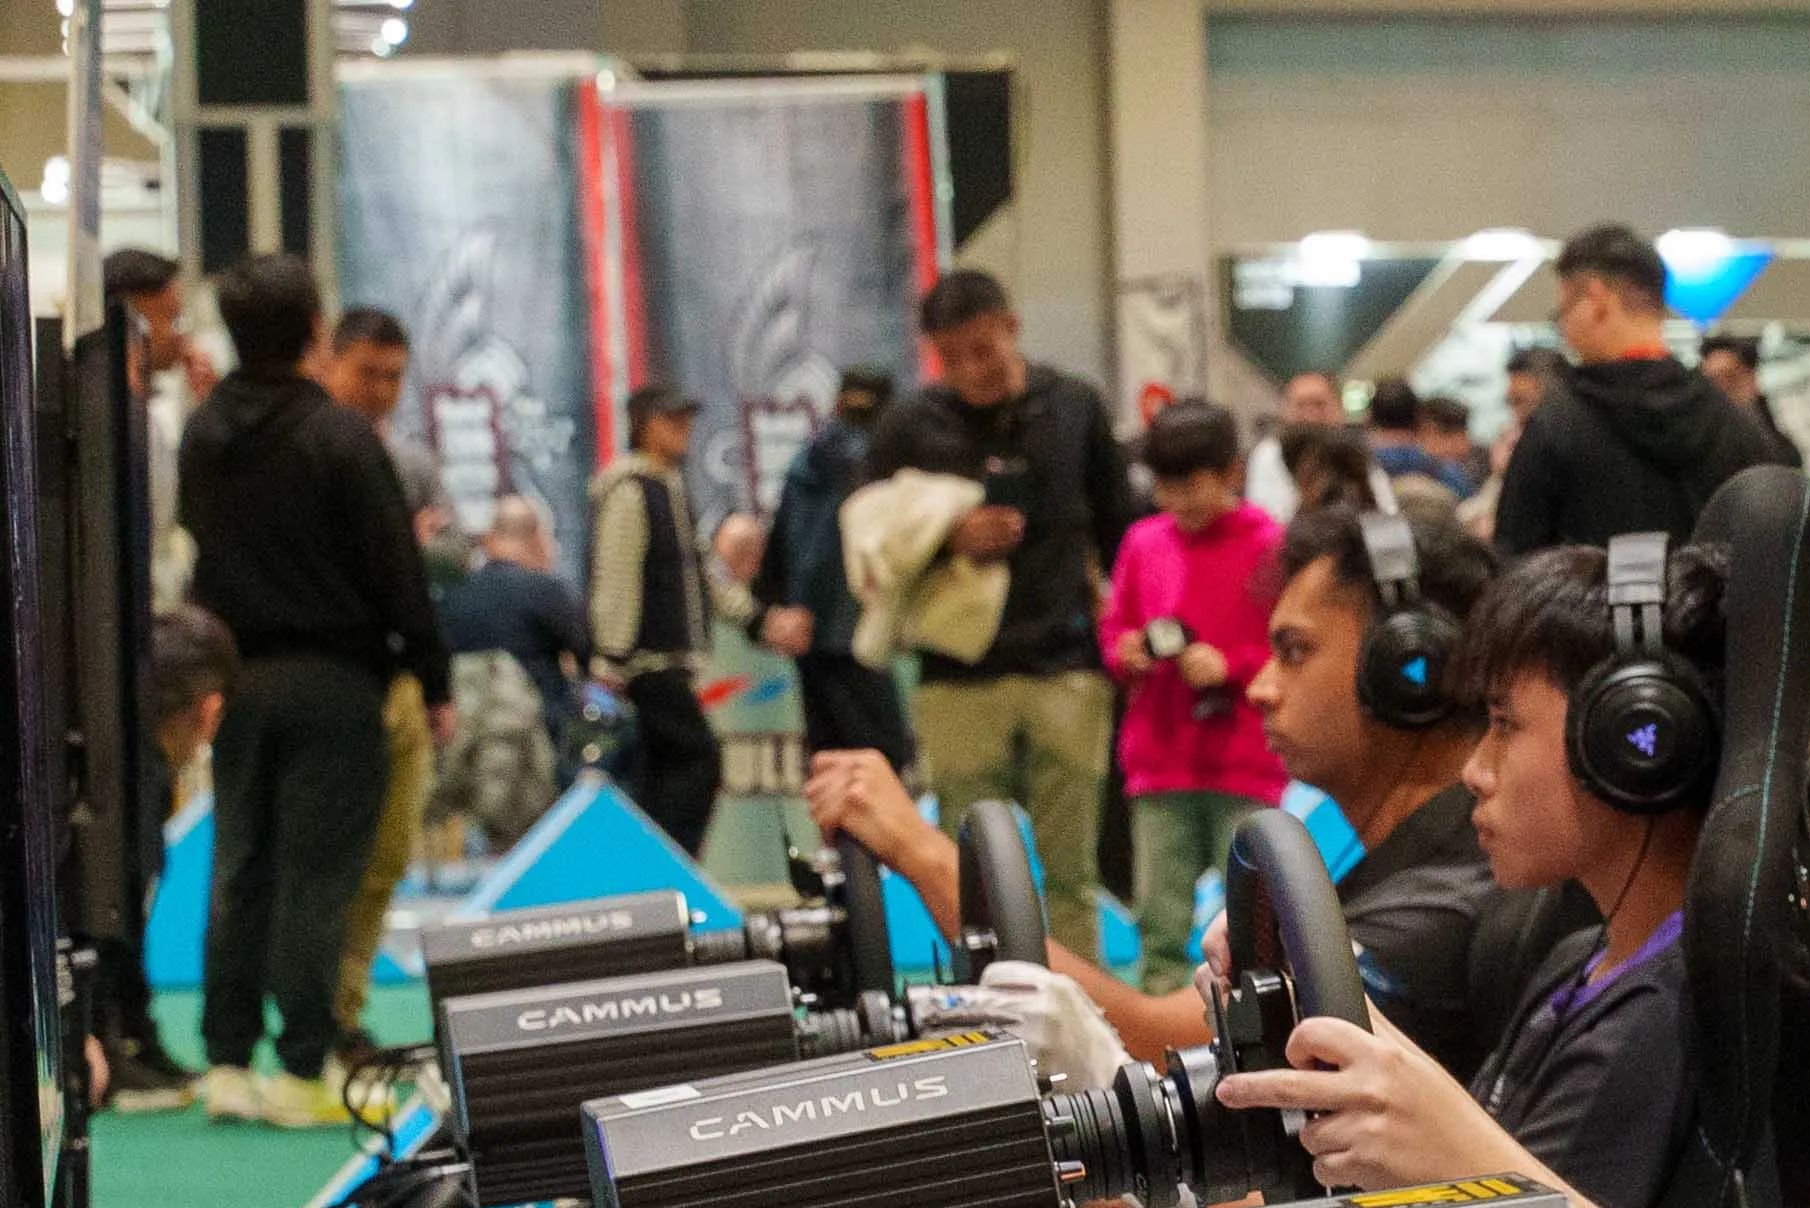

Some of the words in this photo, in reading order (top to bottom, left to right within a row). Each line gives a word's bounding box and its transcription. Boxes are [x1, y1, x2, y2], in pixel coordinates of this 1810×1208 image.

[471, 909, 633, 949] CAMMUS
[517, 987, 723, 1032] CAMMUS
[688, 1075, 949, 1142] CAMMUS
